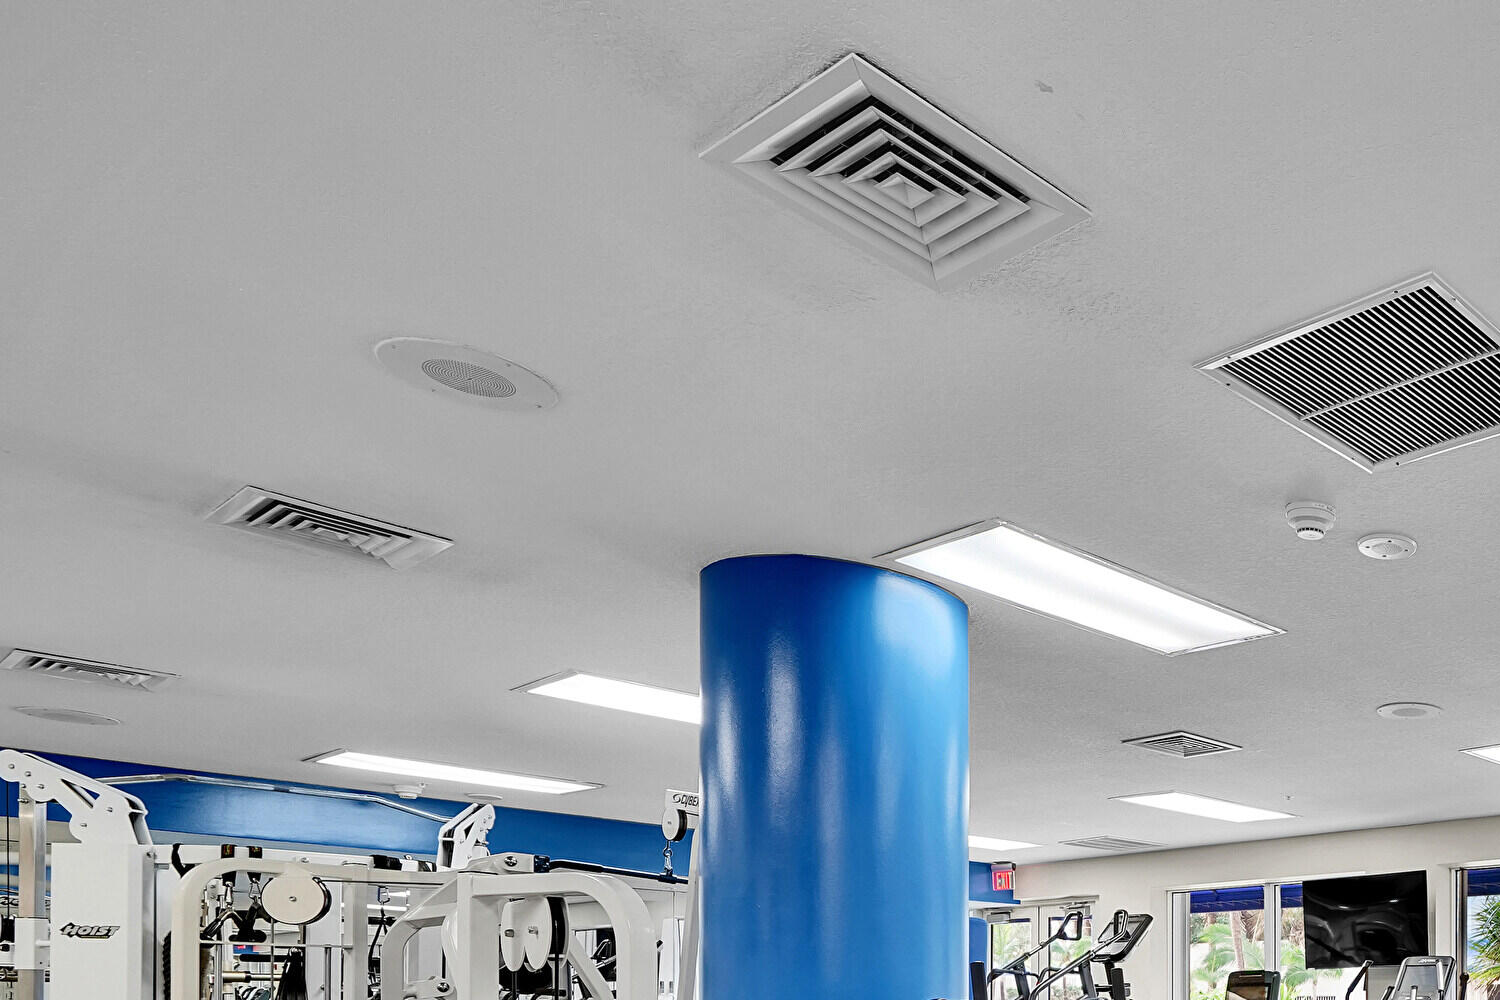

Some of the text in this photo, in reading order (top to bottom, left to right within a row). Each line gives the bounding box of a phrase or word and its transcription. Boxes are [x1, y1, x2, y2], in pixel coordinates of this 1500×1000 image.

[681, 794, 699, 807] CYBE
[996, 871, 1013, 889] EXIT
[61, 925, 120, 937] HOIST
